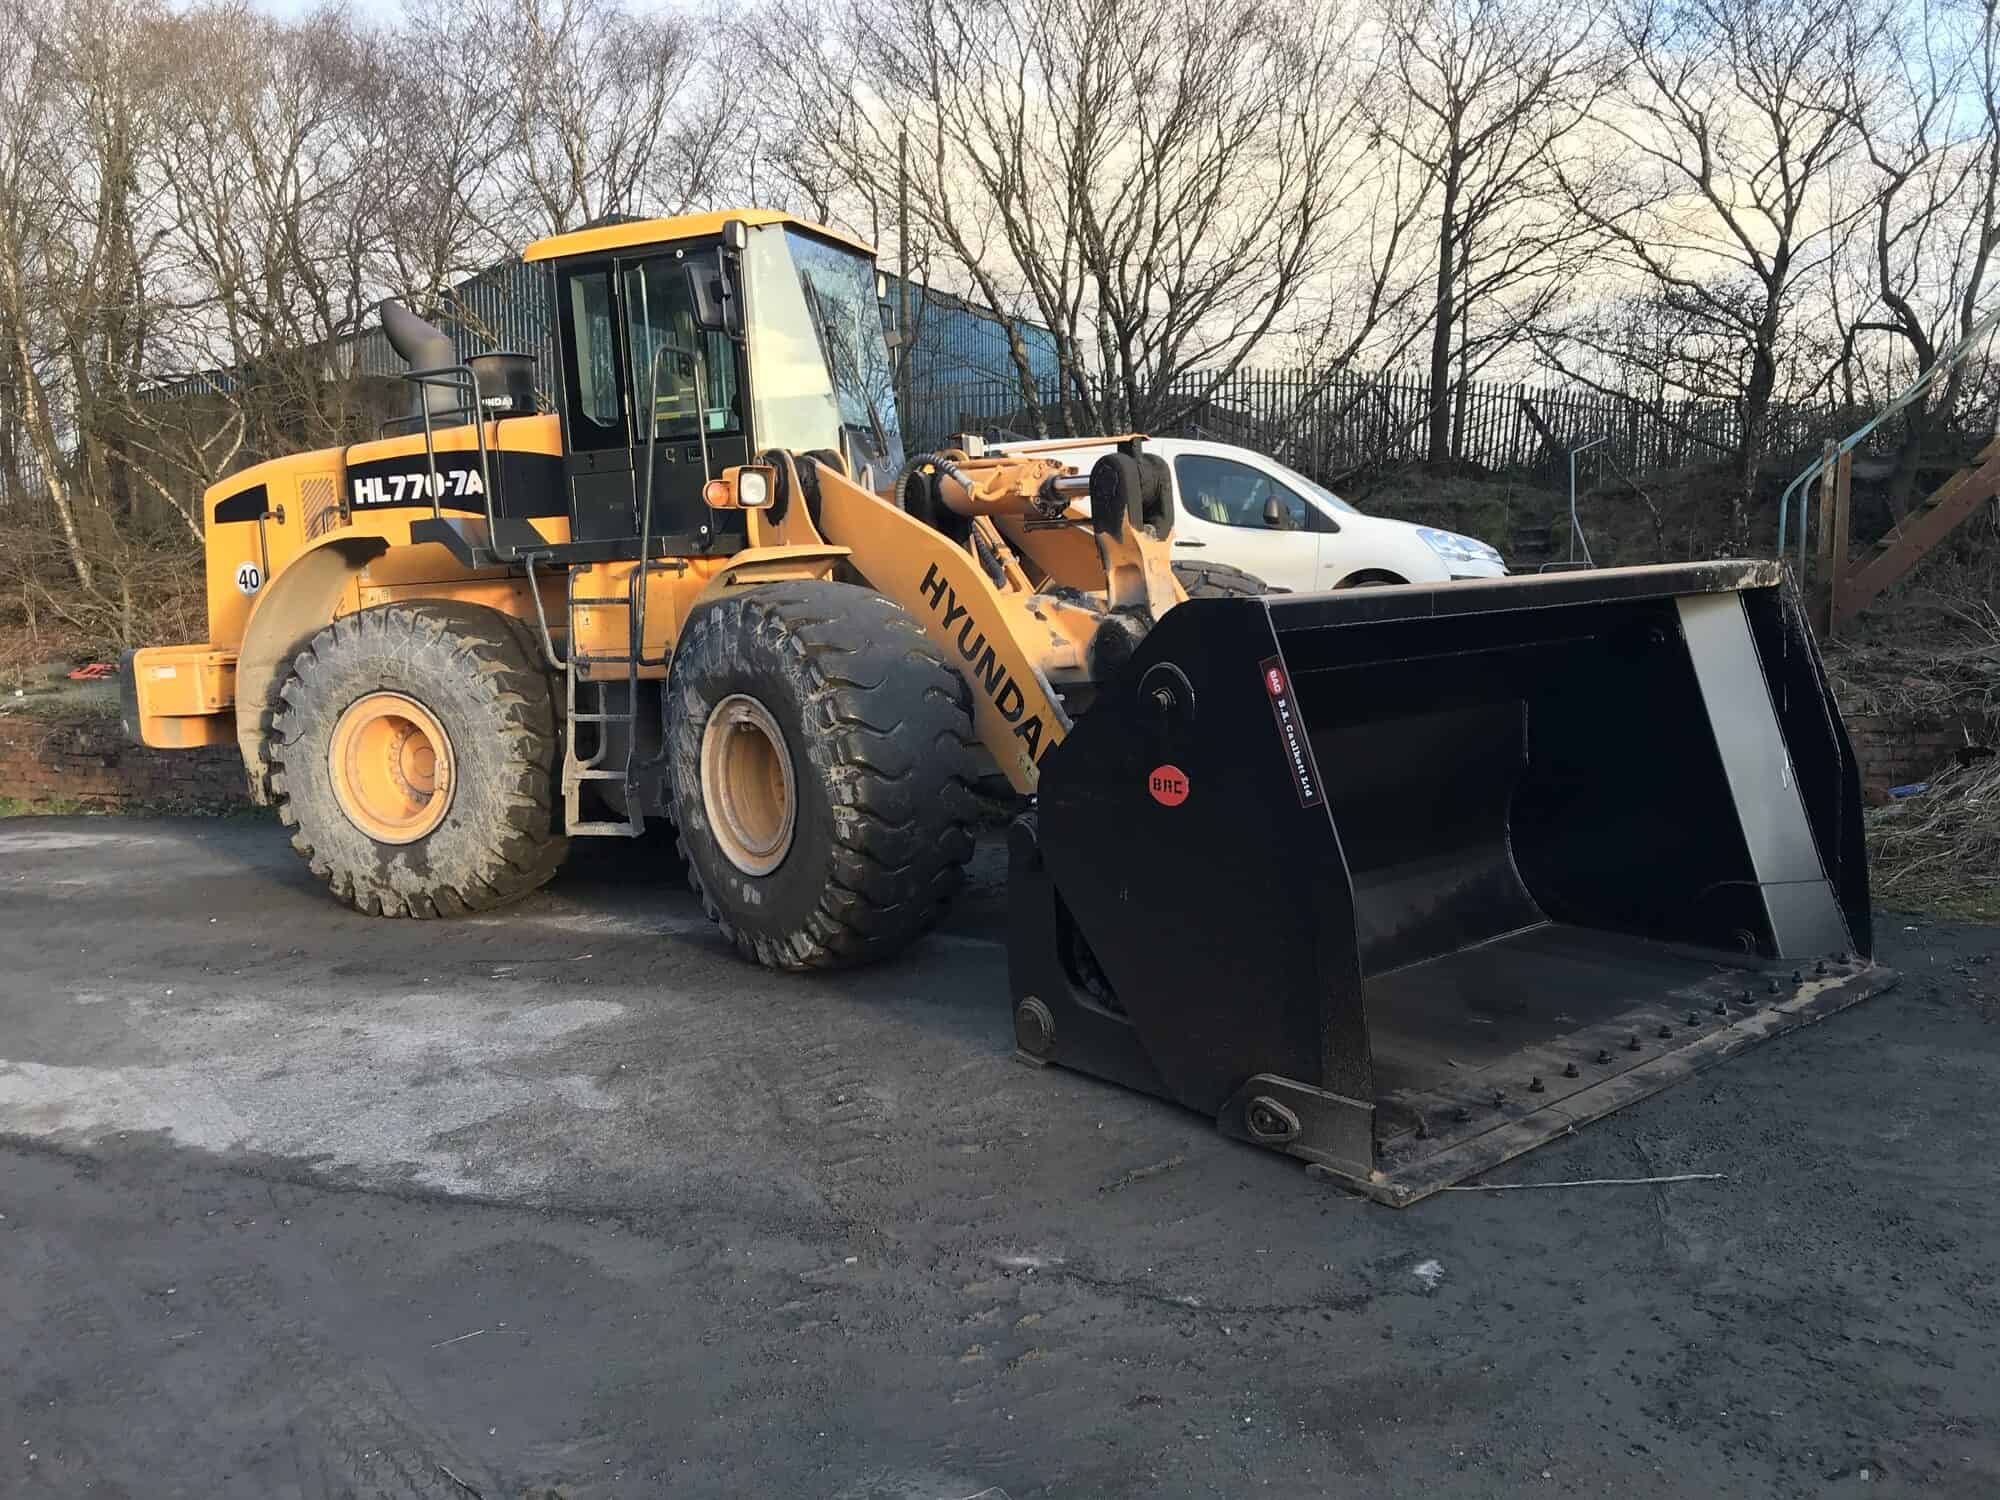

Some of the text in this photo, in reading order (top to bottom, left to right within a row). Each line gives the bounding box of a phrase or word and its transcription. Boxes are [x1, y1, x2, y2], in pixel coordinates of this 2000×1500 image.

[354, 469, 484, 504] HL770-7A
[239, 568, 259, 590] 40
[1301, 775, 1313, 797] Ltd
